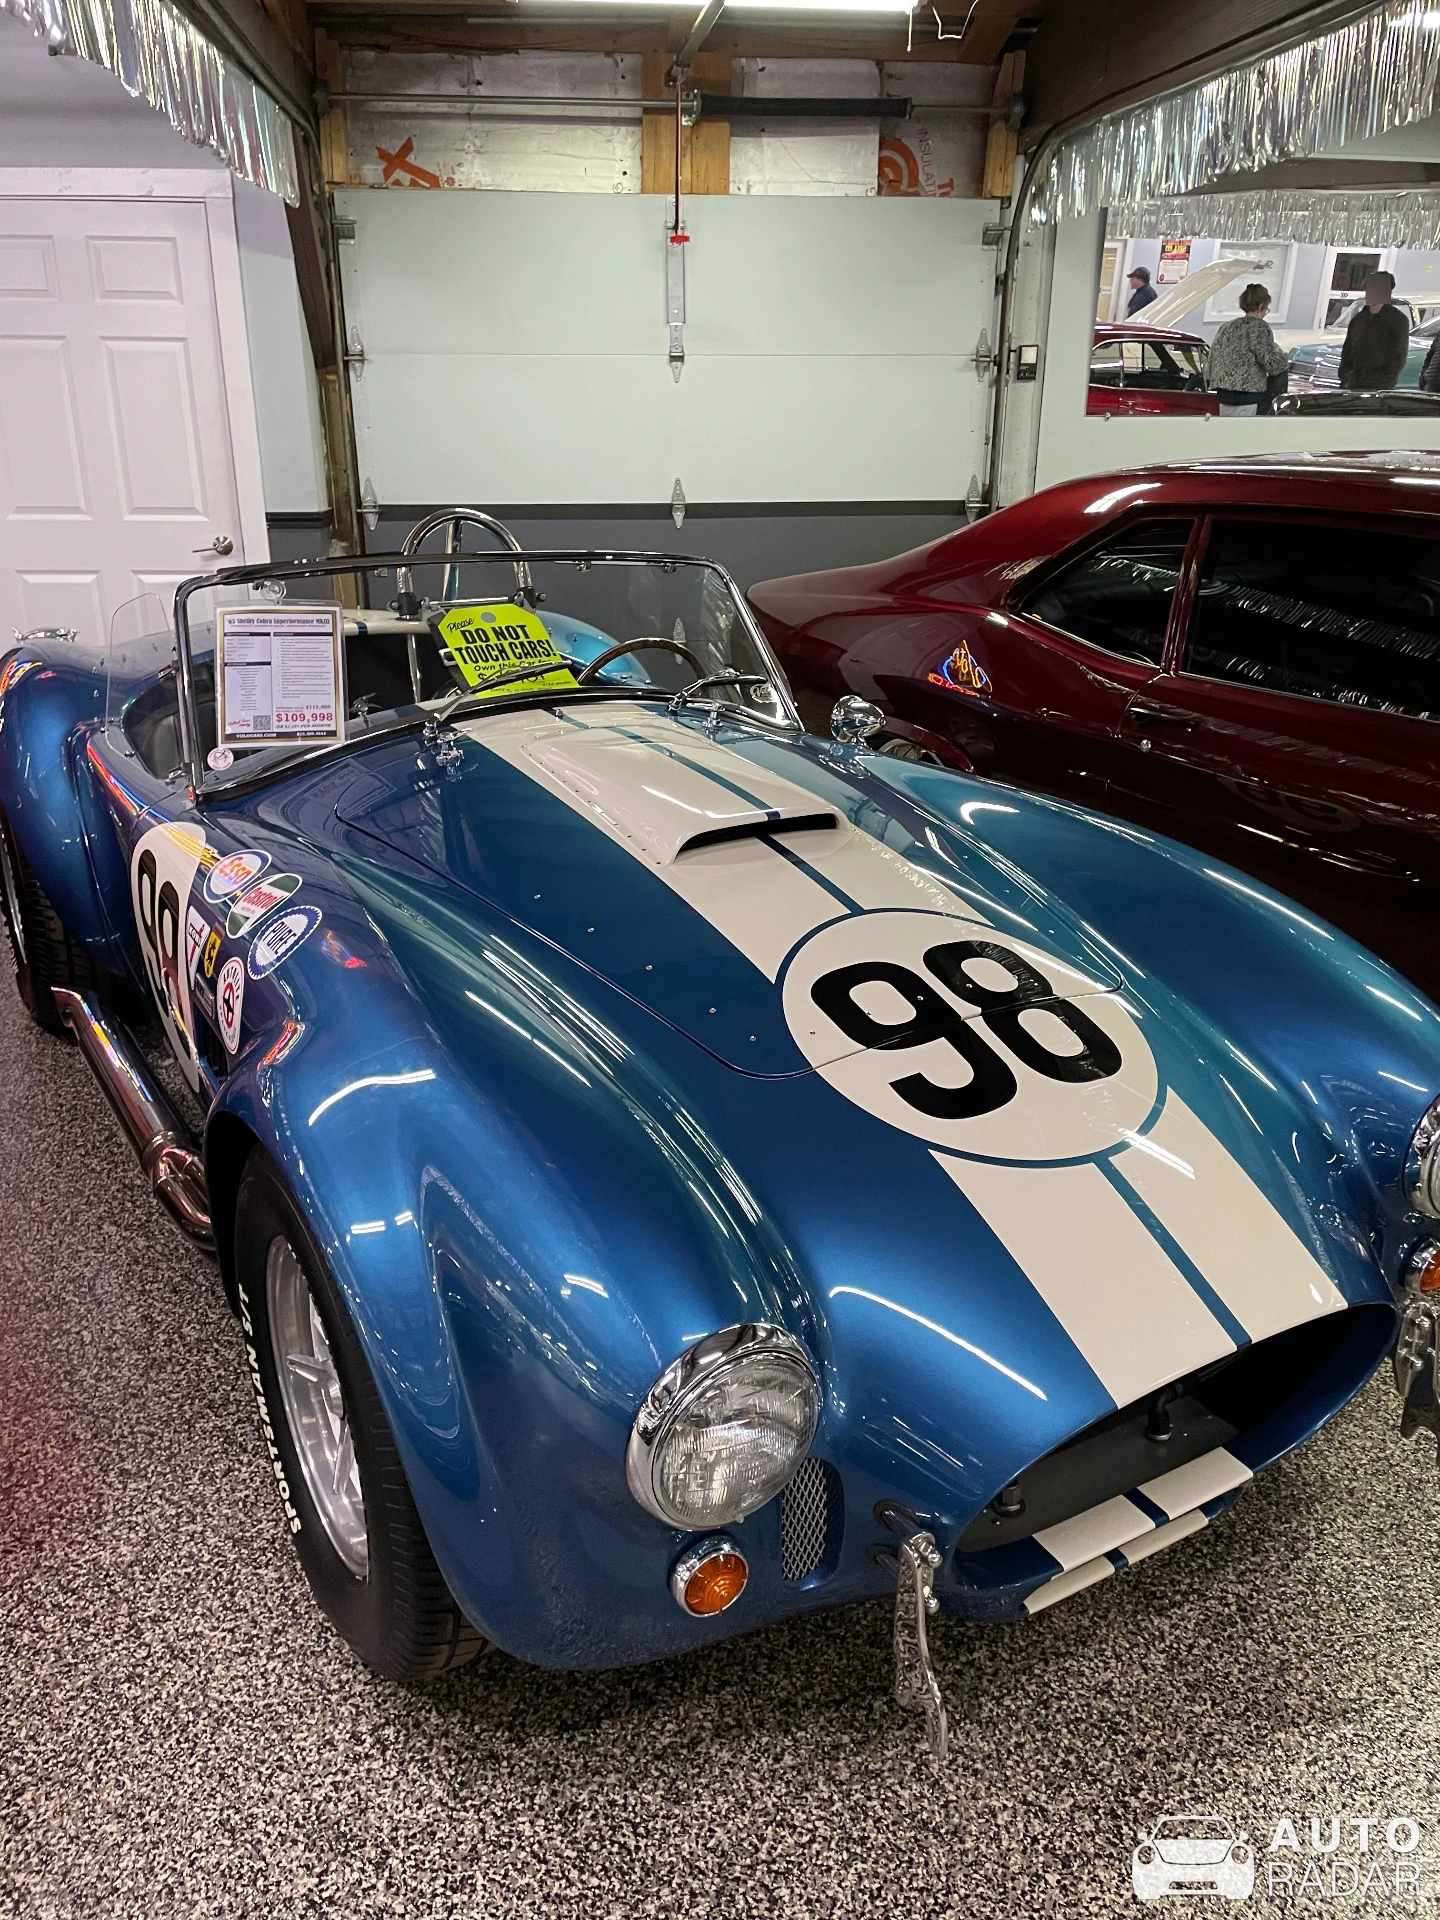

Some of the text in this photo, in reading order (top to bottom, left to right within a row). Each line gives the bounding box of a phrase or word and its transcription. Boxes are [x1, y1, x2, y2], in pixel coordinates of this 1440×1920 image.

[256, 617, 272, 625] Cobra
[446, 618, 475, 633] Please
[460, 624, 531, 645] DO NOT
[454, 639, 558, 665] TOUCH CARS!
[473, 663, 496, 672] Own
[275, 712, 333, 723] $109,998
[218, 856, 252, 886] Esso
[242, 886, 285, 910] Castrol
[262, 920, 298, 956] PURE
[810, 940, 1122, 1119] 98
[247, 1344, 302, 1534] SPORTSMAN
